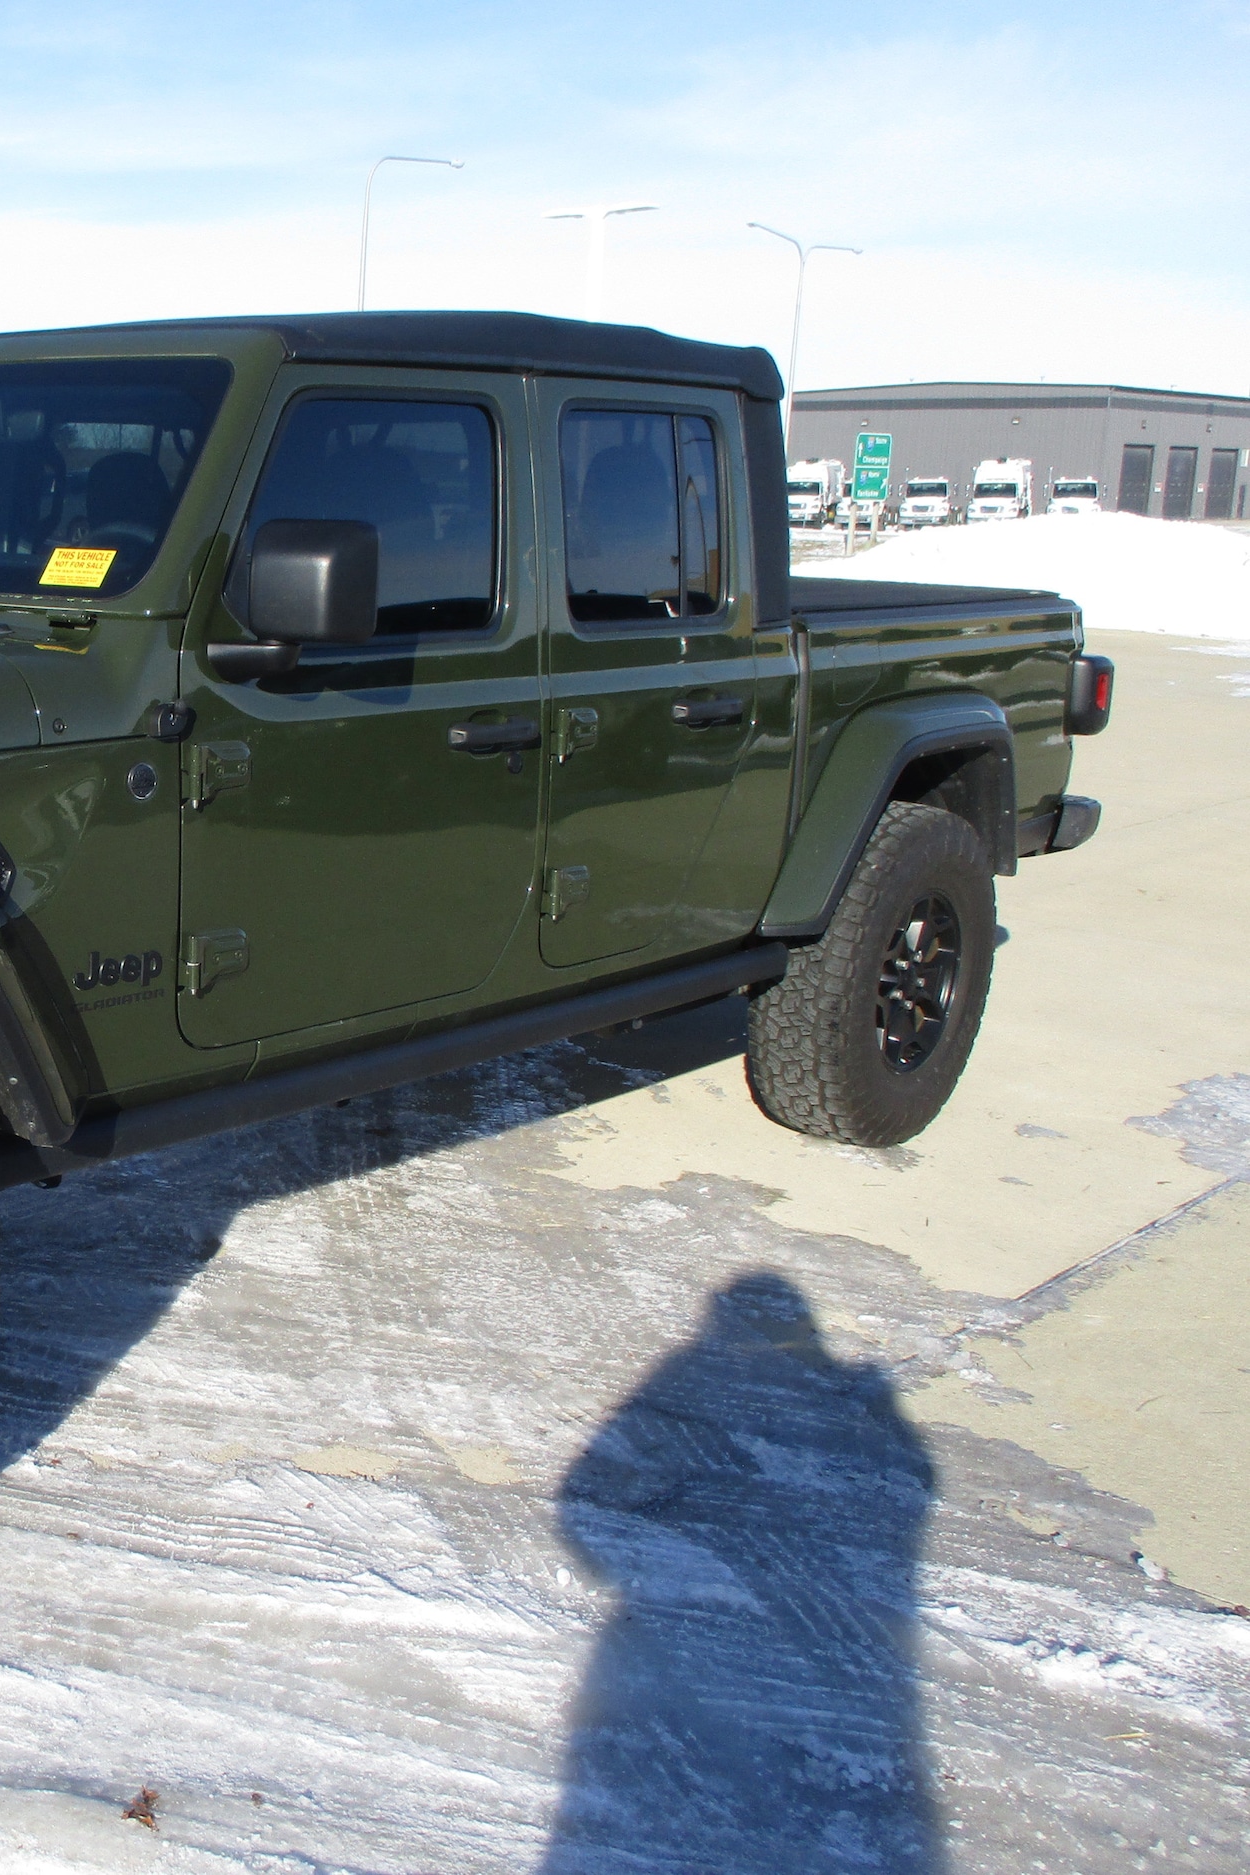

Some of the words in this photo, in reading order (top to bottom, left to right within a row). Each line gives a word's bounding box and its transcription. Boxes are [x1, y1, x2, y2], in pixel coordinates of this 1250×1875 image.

[57, 551, 75, 560] THIS
[76, 551, 111, 561] VEHICLE
[68, 561, 84, 569] FOR
[85, 562, 105, 570] SALE
[72, 950, 163, 991] Jeep
